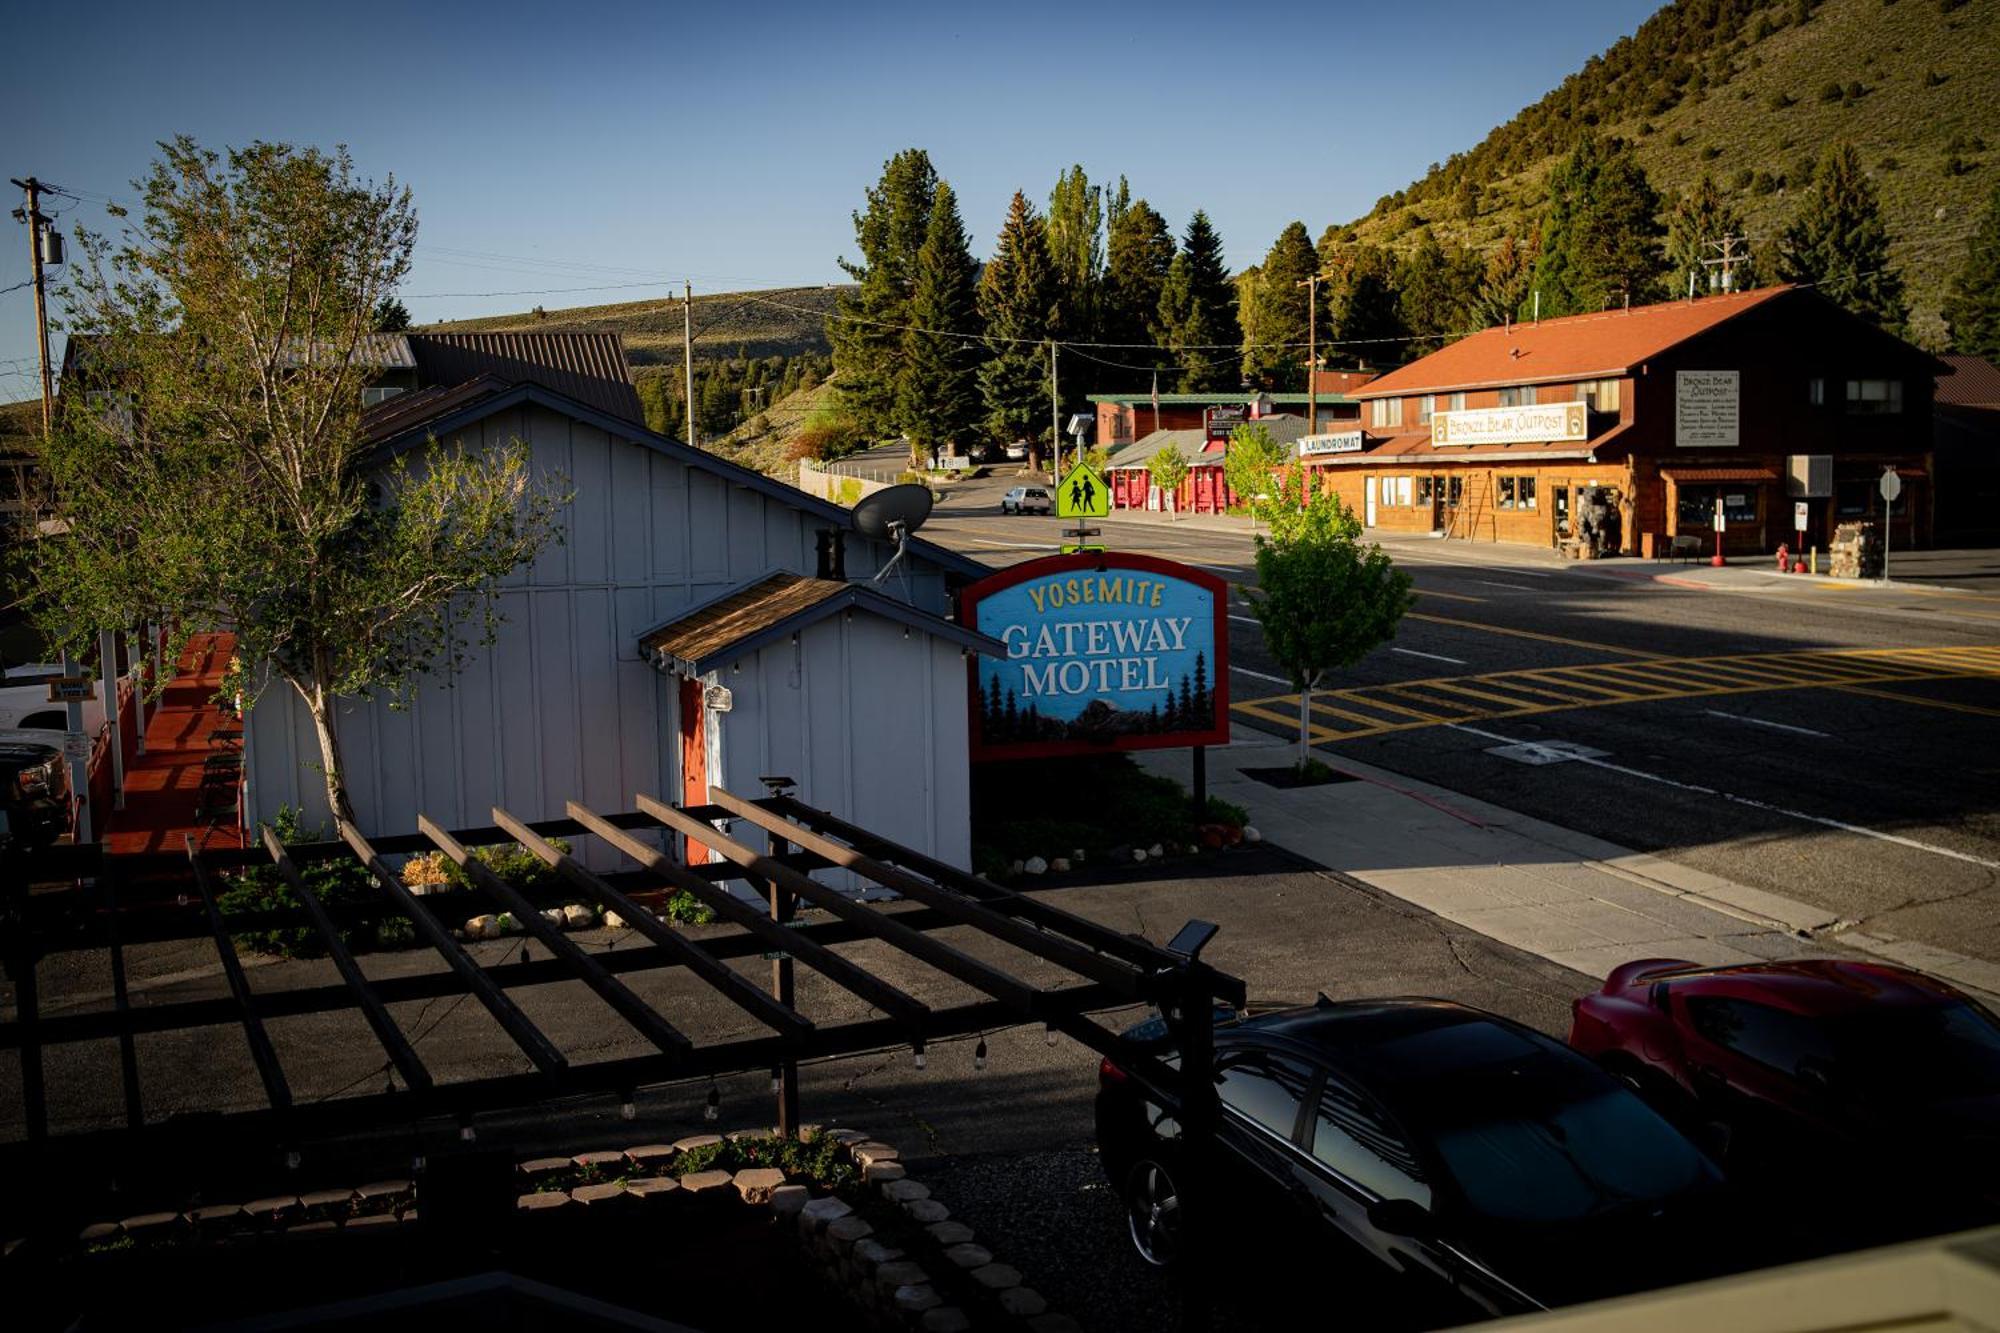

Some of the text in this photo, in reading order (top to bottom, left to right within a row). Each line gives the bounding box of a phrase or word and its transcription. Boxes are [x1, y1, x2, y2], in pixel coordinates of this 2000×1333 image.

[1450, 413, 1562, 435] BRONZE BEAR OUTPOST
[1306, 437, 1359, 451] LAUNDROMAT
[1029, 577, 1165, 612] YOSEMITE
[1002, 617, 1191, 659] GATEWAY
[1022, 657, 1169, 697] MOTEL
